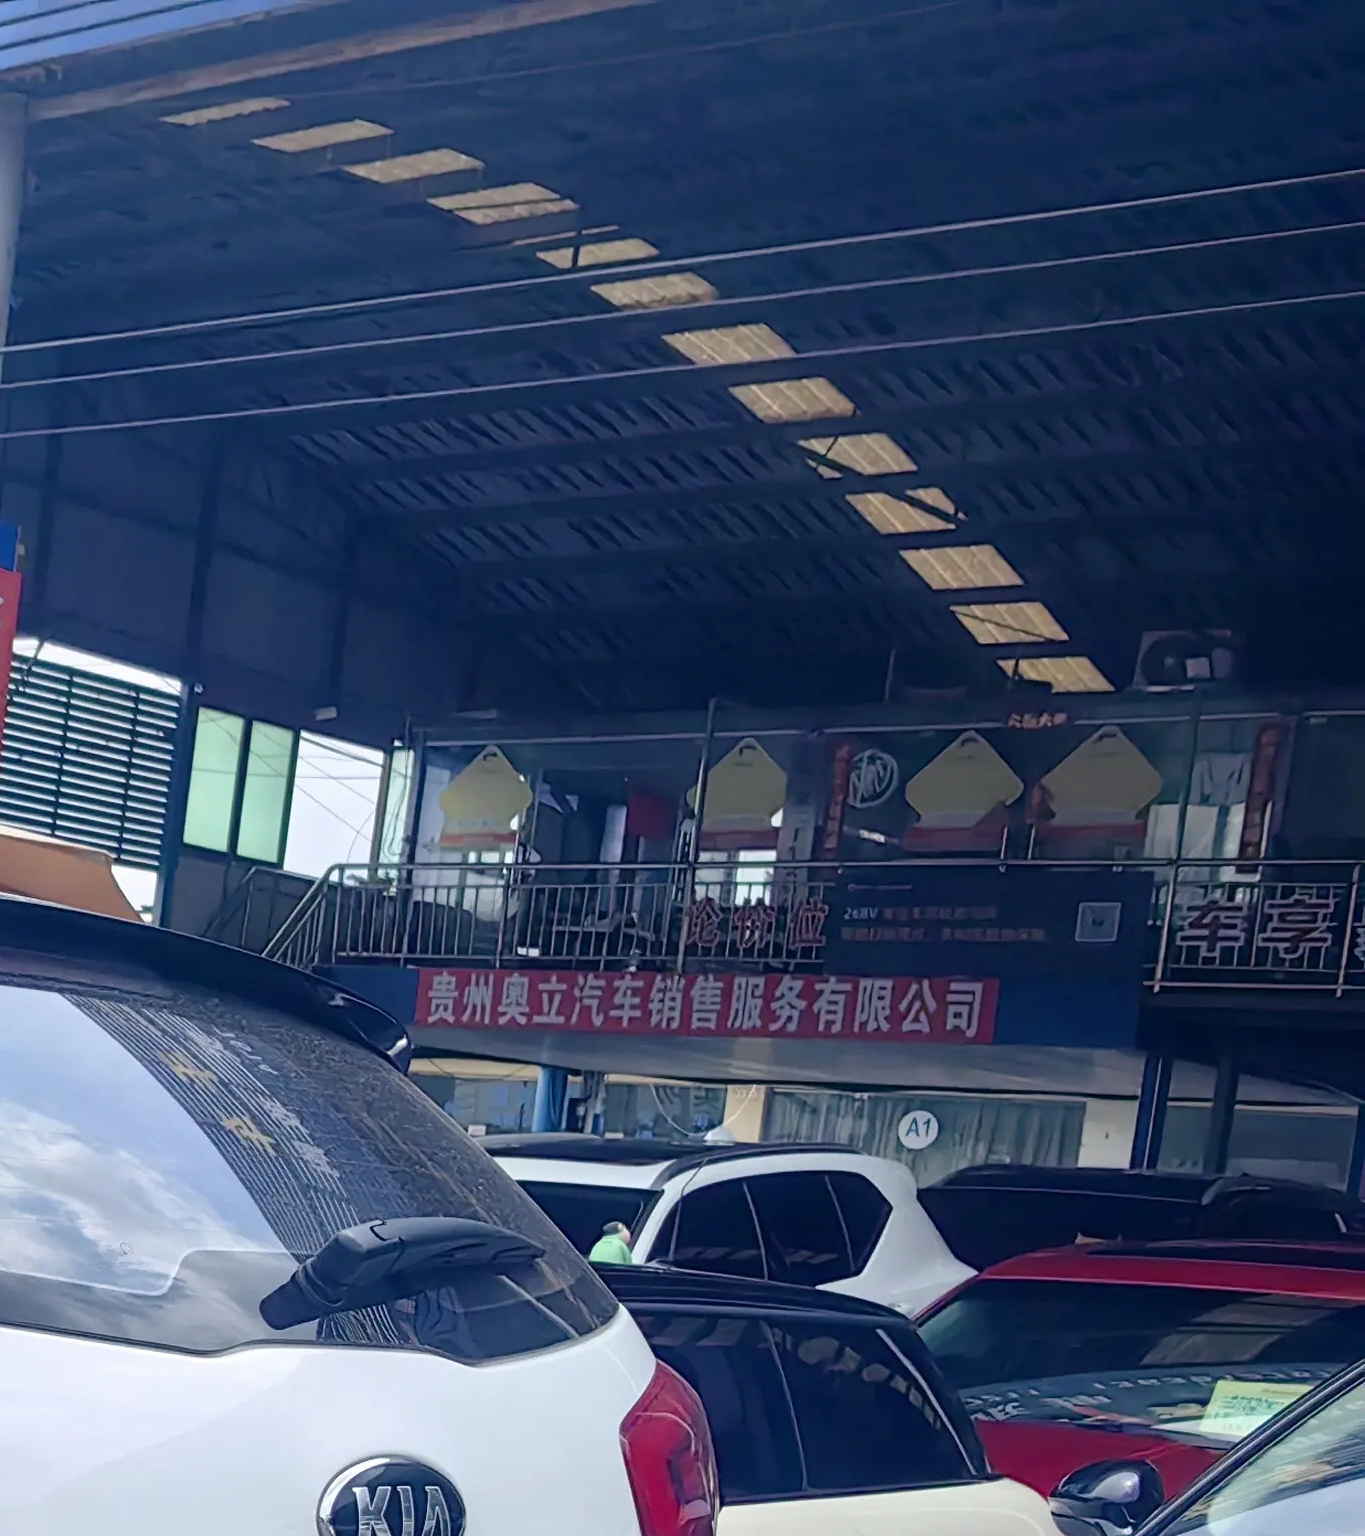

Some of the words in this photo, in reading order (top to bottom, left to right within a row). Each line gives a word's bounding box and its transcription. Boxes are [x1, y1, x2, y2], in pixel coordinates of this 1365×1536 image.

[426, 973, 983, 1038] 贵州奥立汽车销售服务有限公司
[904, 1116, 932, 1138] A1
